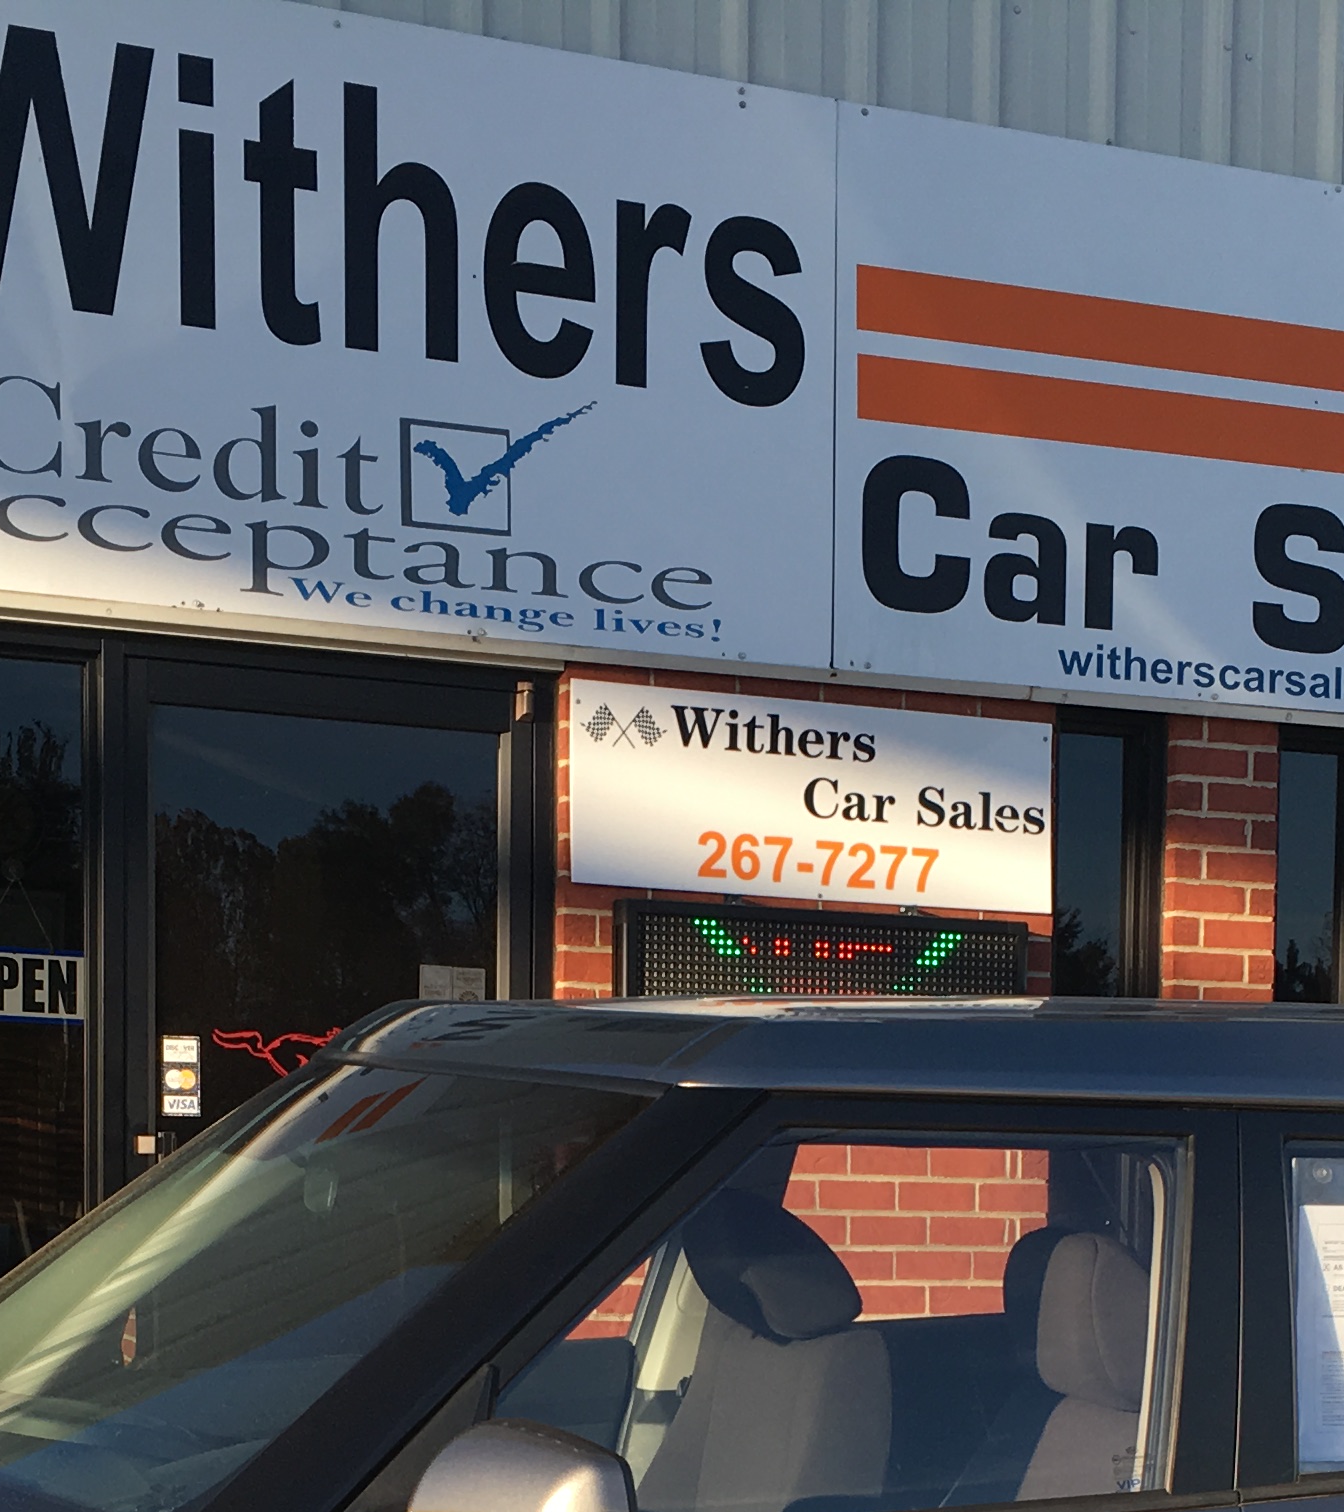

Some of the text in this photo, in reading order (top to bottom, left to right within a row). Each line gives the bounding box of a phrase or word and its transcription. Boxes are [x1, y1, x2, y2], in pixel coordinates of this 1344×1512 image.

[861, 454, 1160, 632] Car
[289, 576, 723, 643] We change lives!
[671, 704, 877, 763] Withers
[803, 776, 1046, 835] Car Sales
[697, 830, 940, 893] 267-7277
[168, 1098, 196, 1110] VISA
